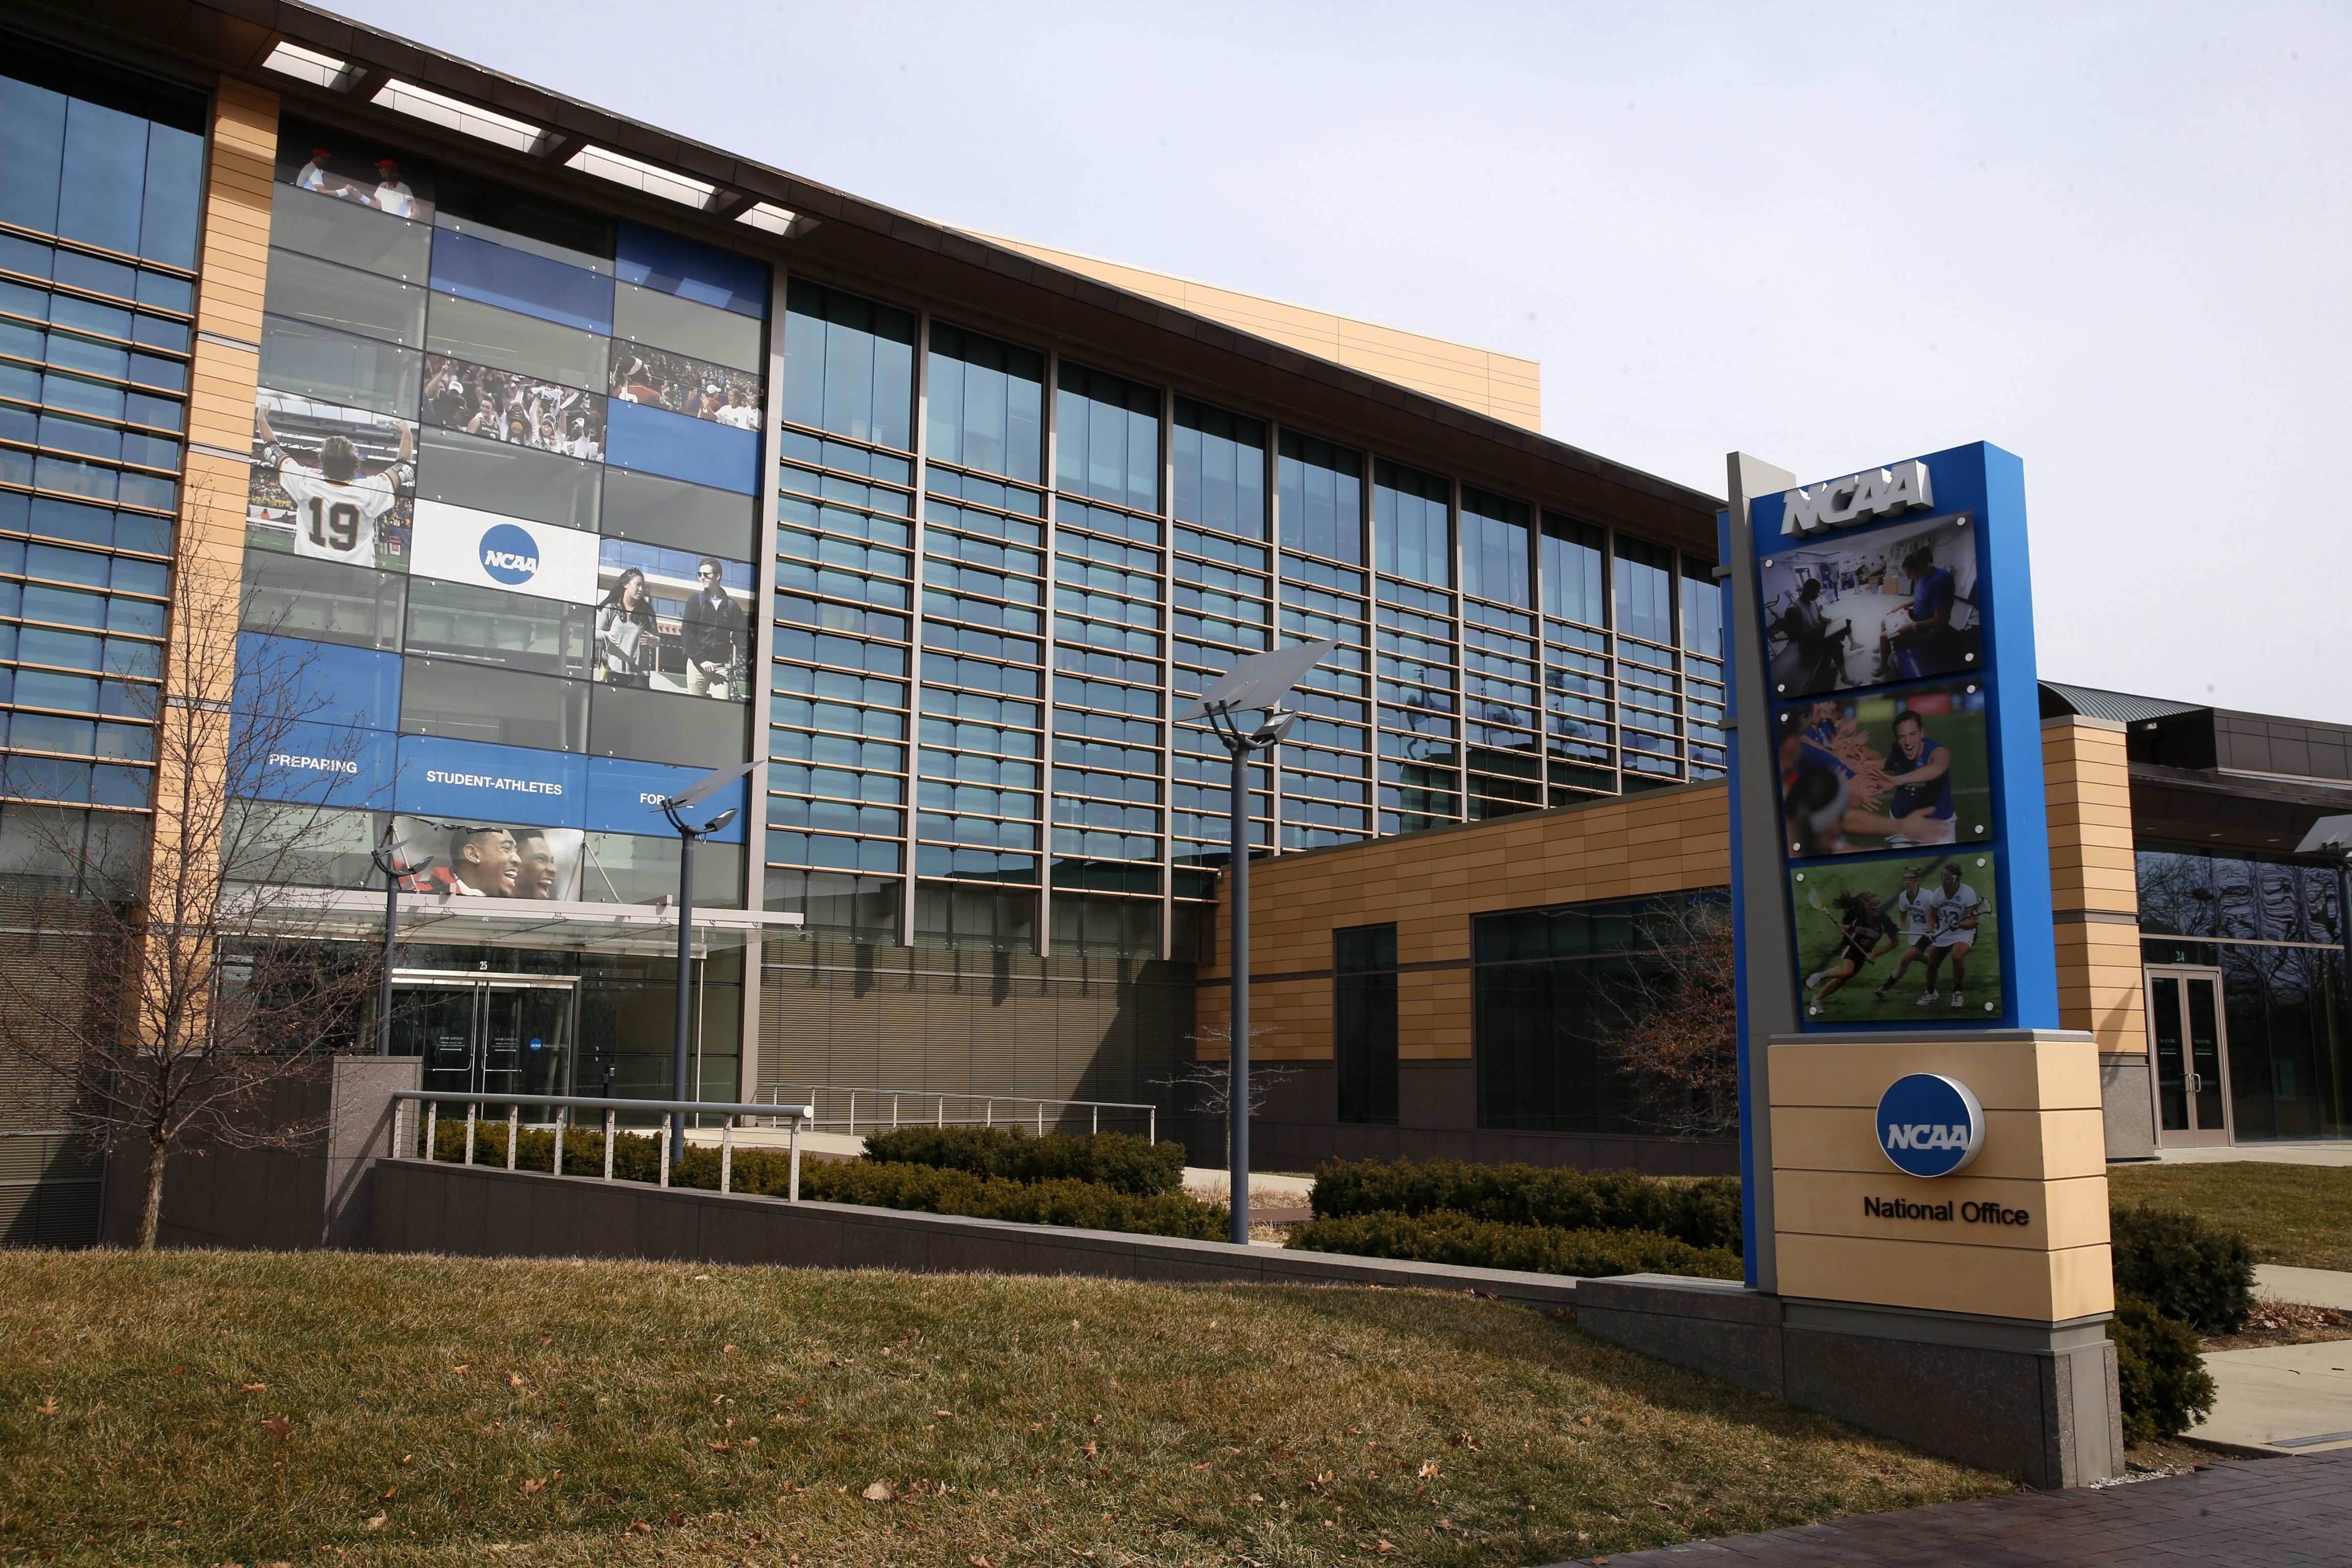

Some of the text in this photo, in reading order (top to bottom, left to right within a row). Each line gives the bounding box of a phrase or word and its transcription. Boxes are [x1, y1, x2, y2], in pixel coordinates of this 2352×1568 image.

[1780, 459, 1933, 537] NCAA
[309, 495, 361, 552] 19
[484, 550, 536, 574] NCAA
[269, 753, 357, 774] PREPARING
[426, 770, 562, 795] STUDENT-ATHLETES
[480, 961, 487, 970] 25
[2176, 950, 2185, 962] 24
[1887, 1124, 1969, 1150] NCAA
[1864, 1196, 2029, 1226] National Office
